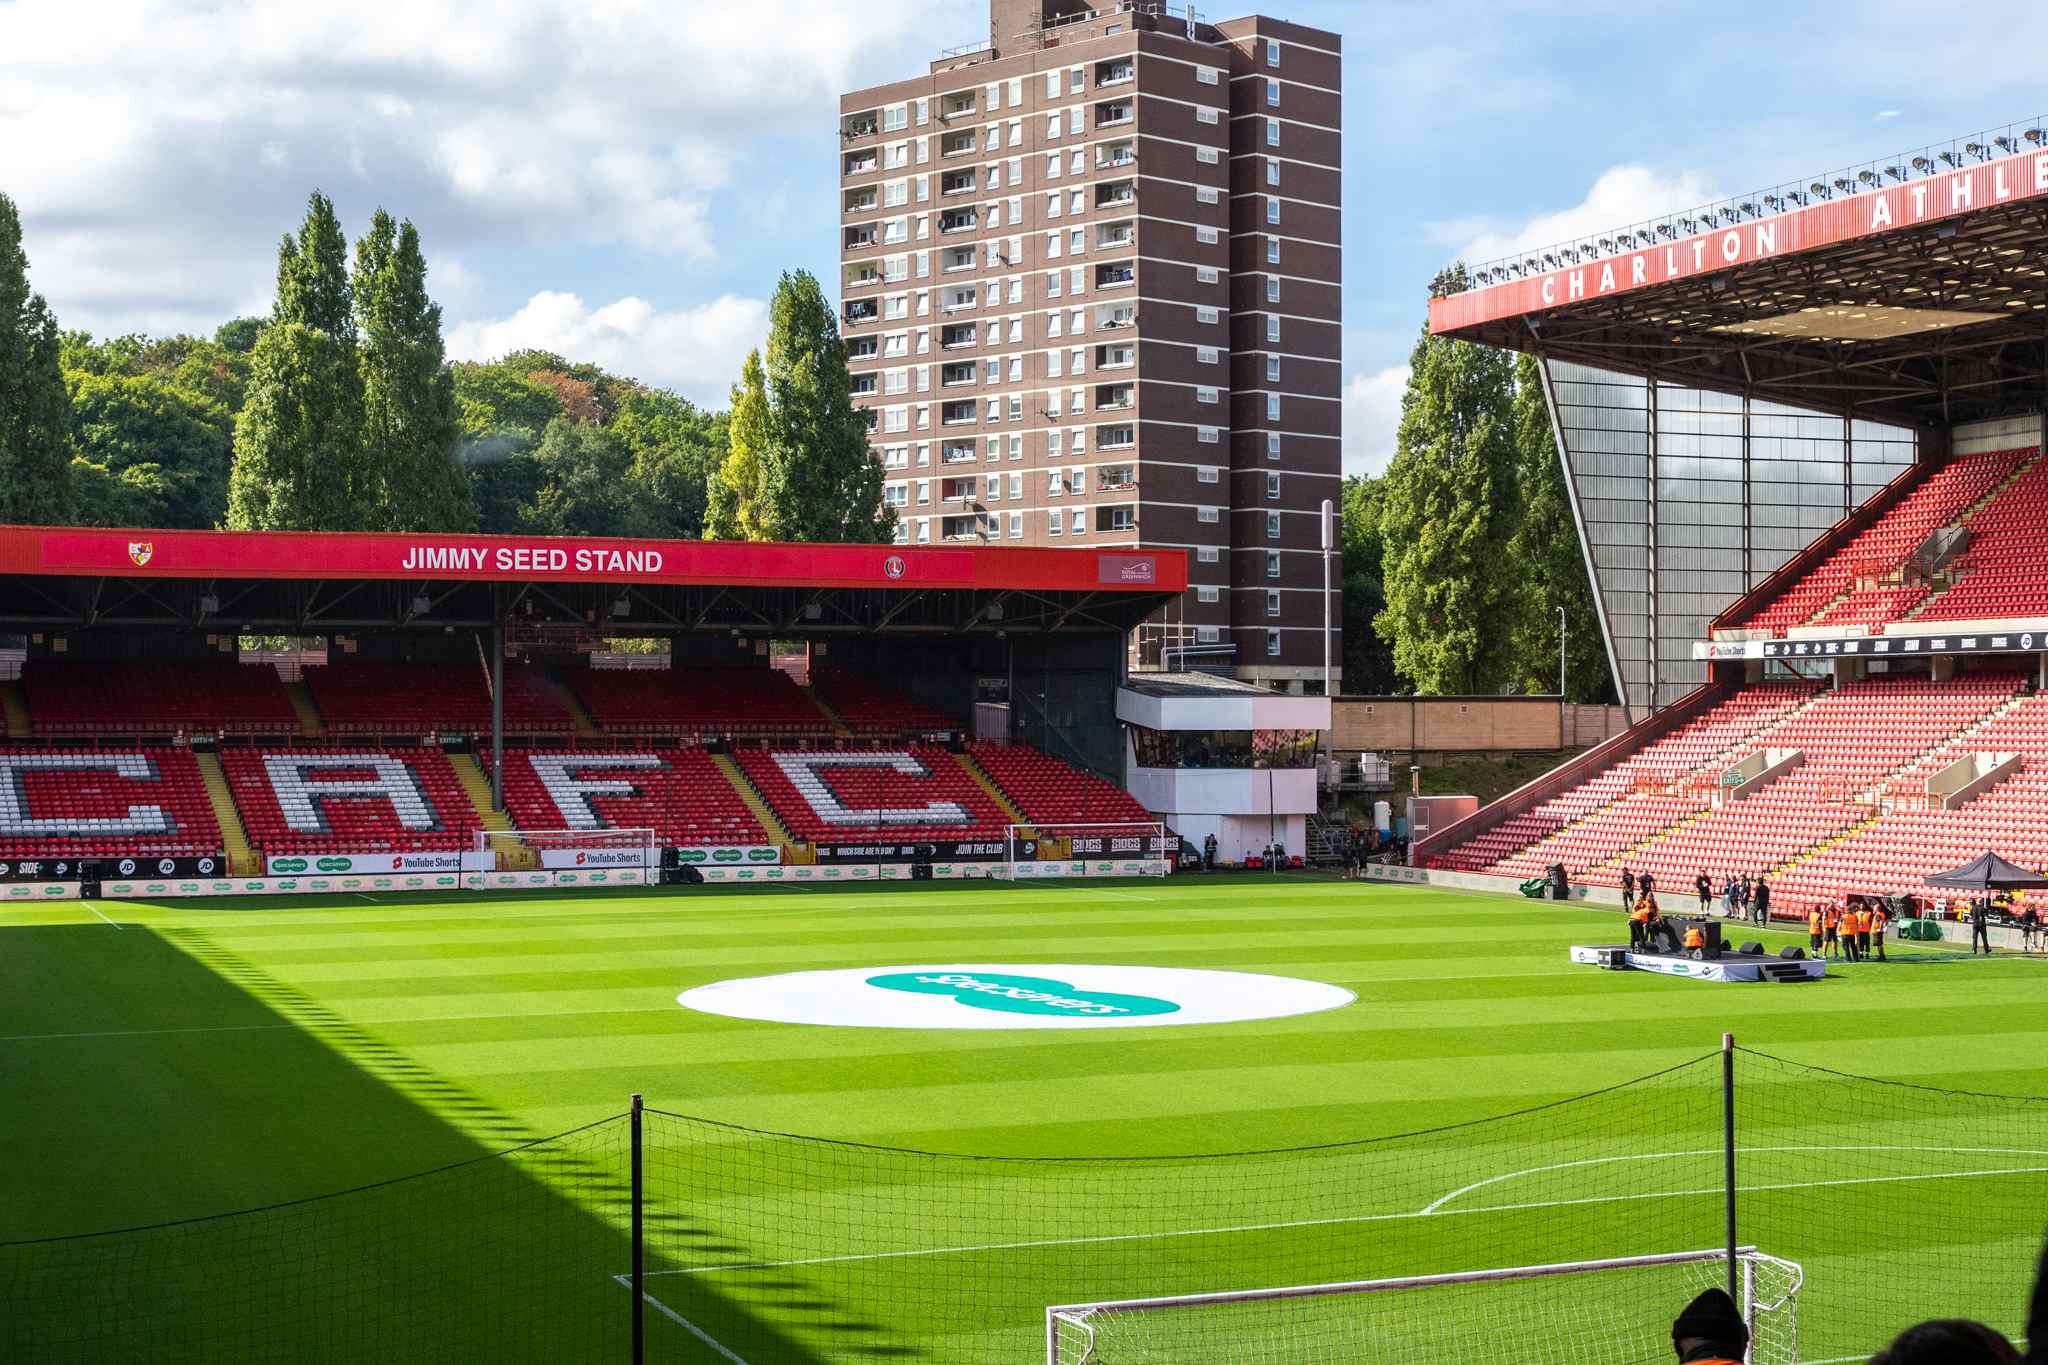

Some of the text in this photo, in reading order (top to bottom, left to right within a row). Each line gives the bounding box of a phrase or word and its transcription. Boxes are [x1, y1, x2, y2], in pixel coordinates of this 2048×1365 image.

[1542, 155, 2048, 304] CHARLTON ATHLE
[402, 547, 663, 573] JIMMY SEED STAND
[956, 843, 1003, 854] JOIN THE CLUB
[404, 857, 461, 867] YouTube Shorts
[587, 853, 640, 863] YouTube Shorts
